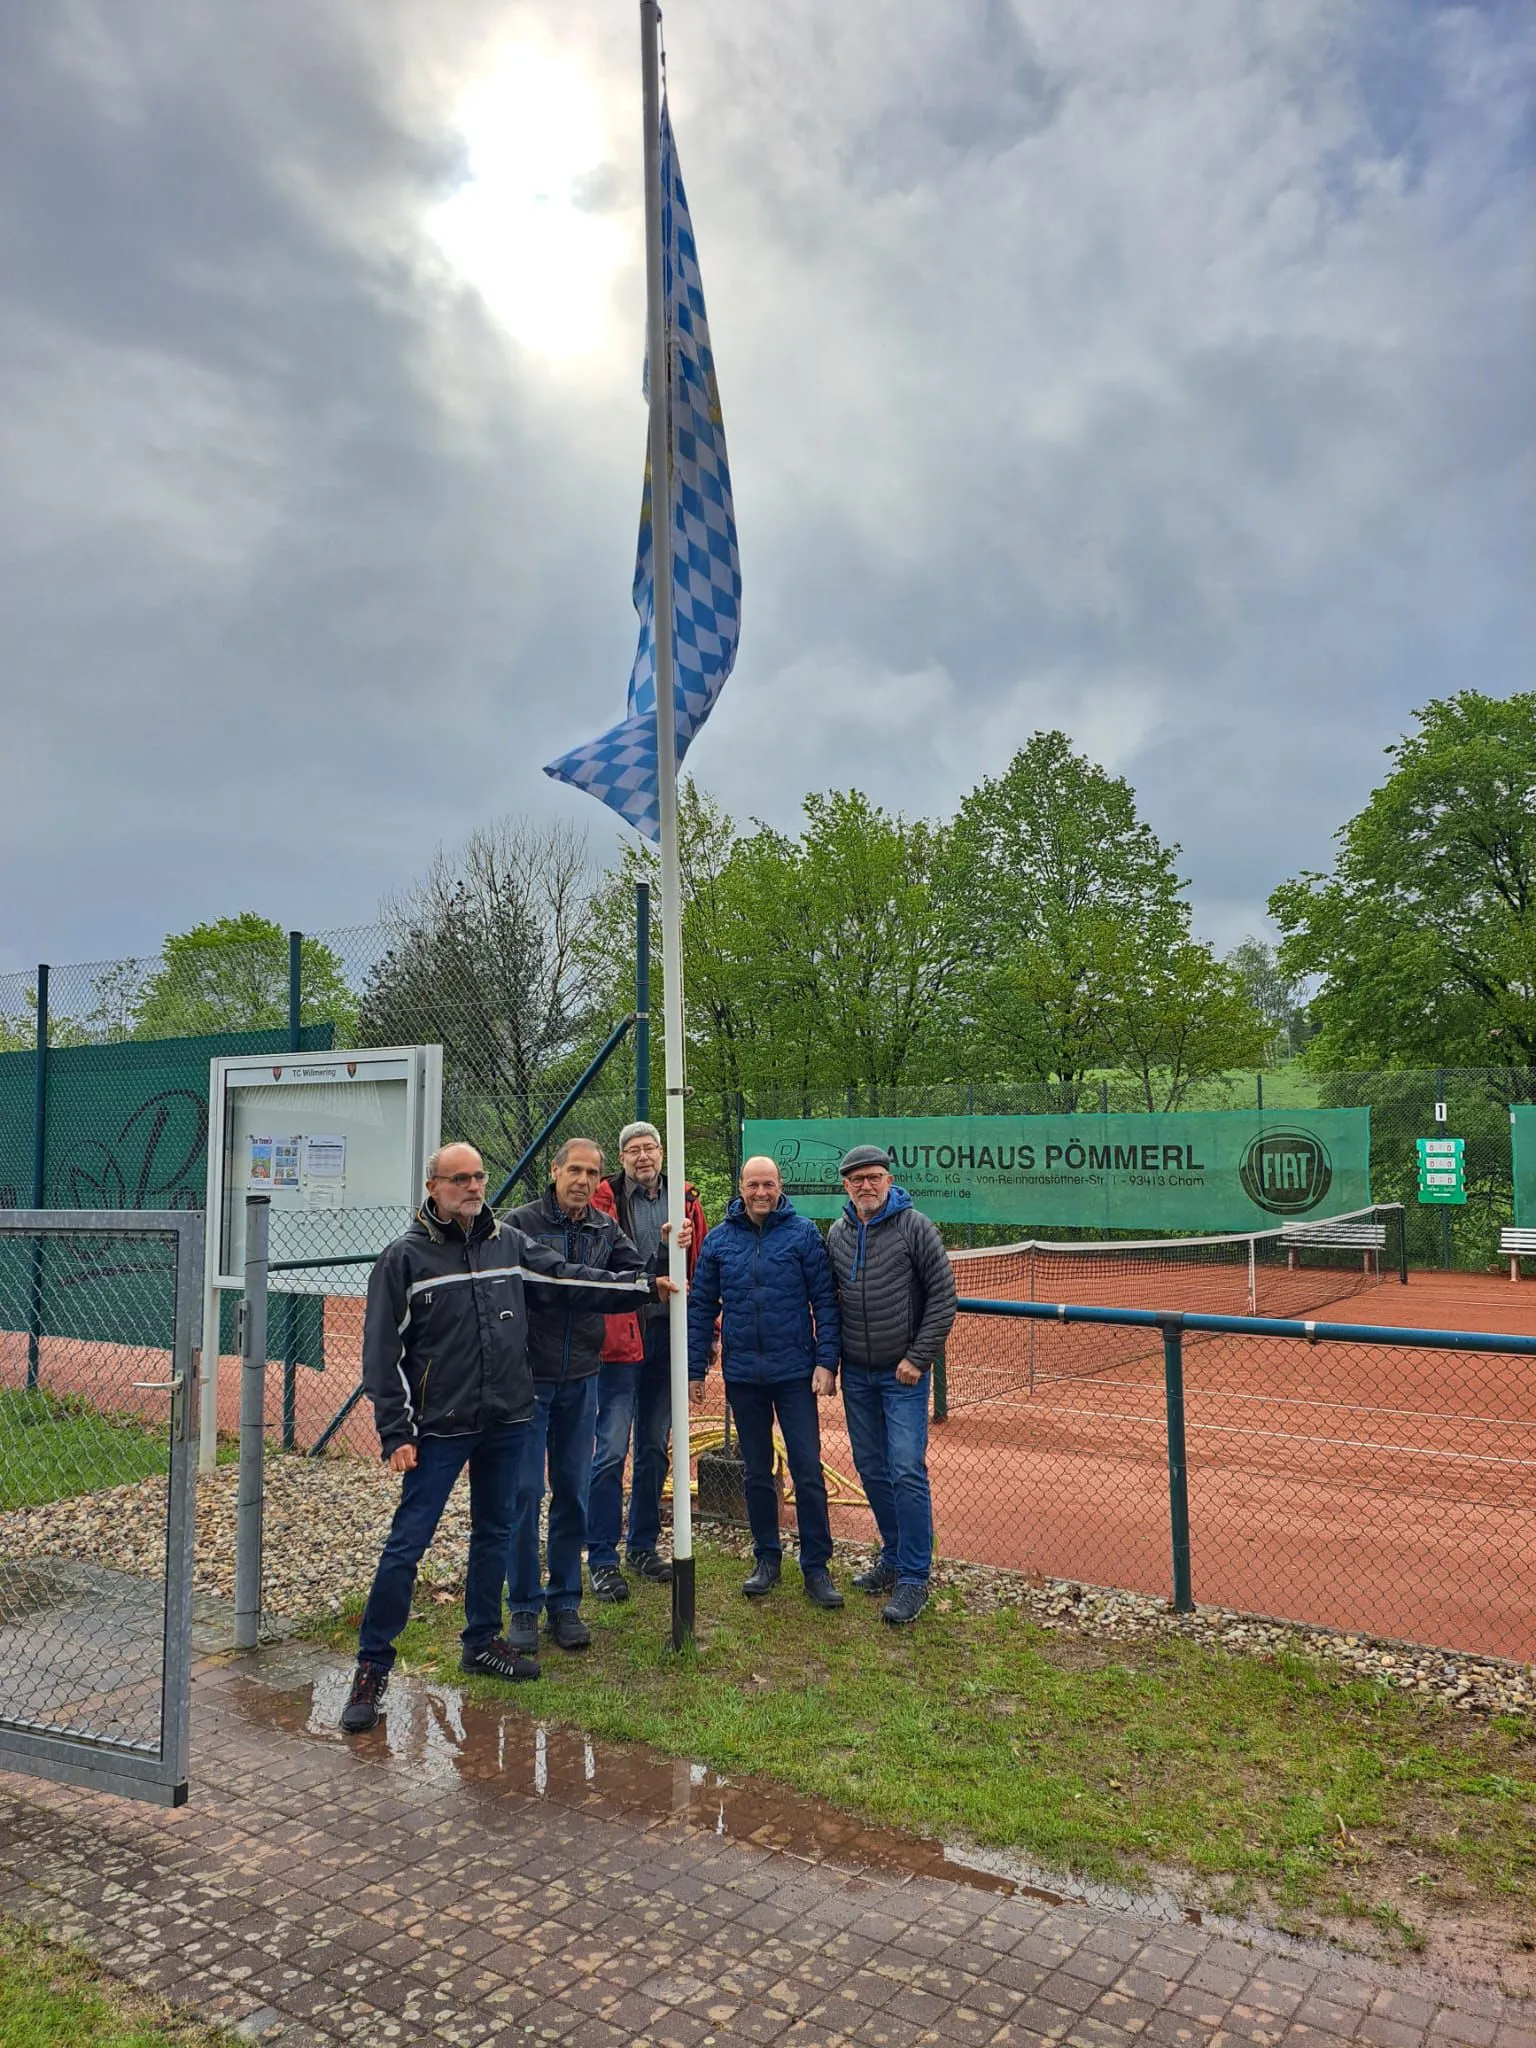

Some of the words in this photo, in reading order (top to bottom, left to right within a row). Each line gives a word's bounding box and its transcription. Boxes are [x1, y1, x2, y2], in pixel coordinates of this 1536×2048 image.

[292, 1069, 301, 1077] TC
[302, 1068, 337, 1078] Willmering
[887, 1145, 1036, 1170] AUTOHAUS
[1045, 1138, 1205, 1170] PÖMMERL
[1262, 1152, 1311, 1189] FIAT
[893, 1172, 913, 1183] mbH
[915, 1172, 923, 1183] &
[925, 1173, 942, 1183] Co.
[945, 1173, 961, 1184] KG
[1129, 1175, 1166, 1186] 93413
[1168, 1175, 1204, 1187] Cham
[909, 1187, 971, 1199] poemmerl.de
